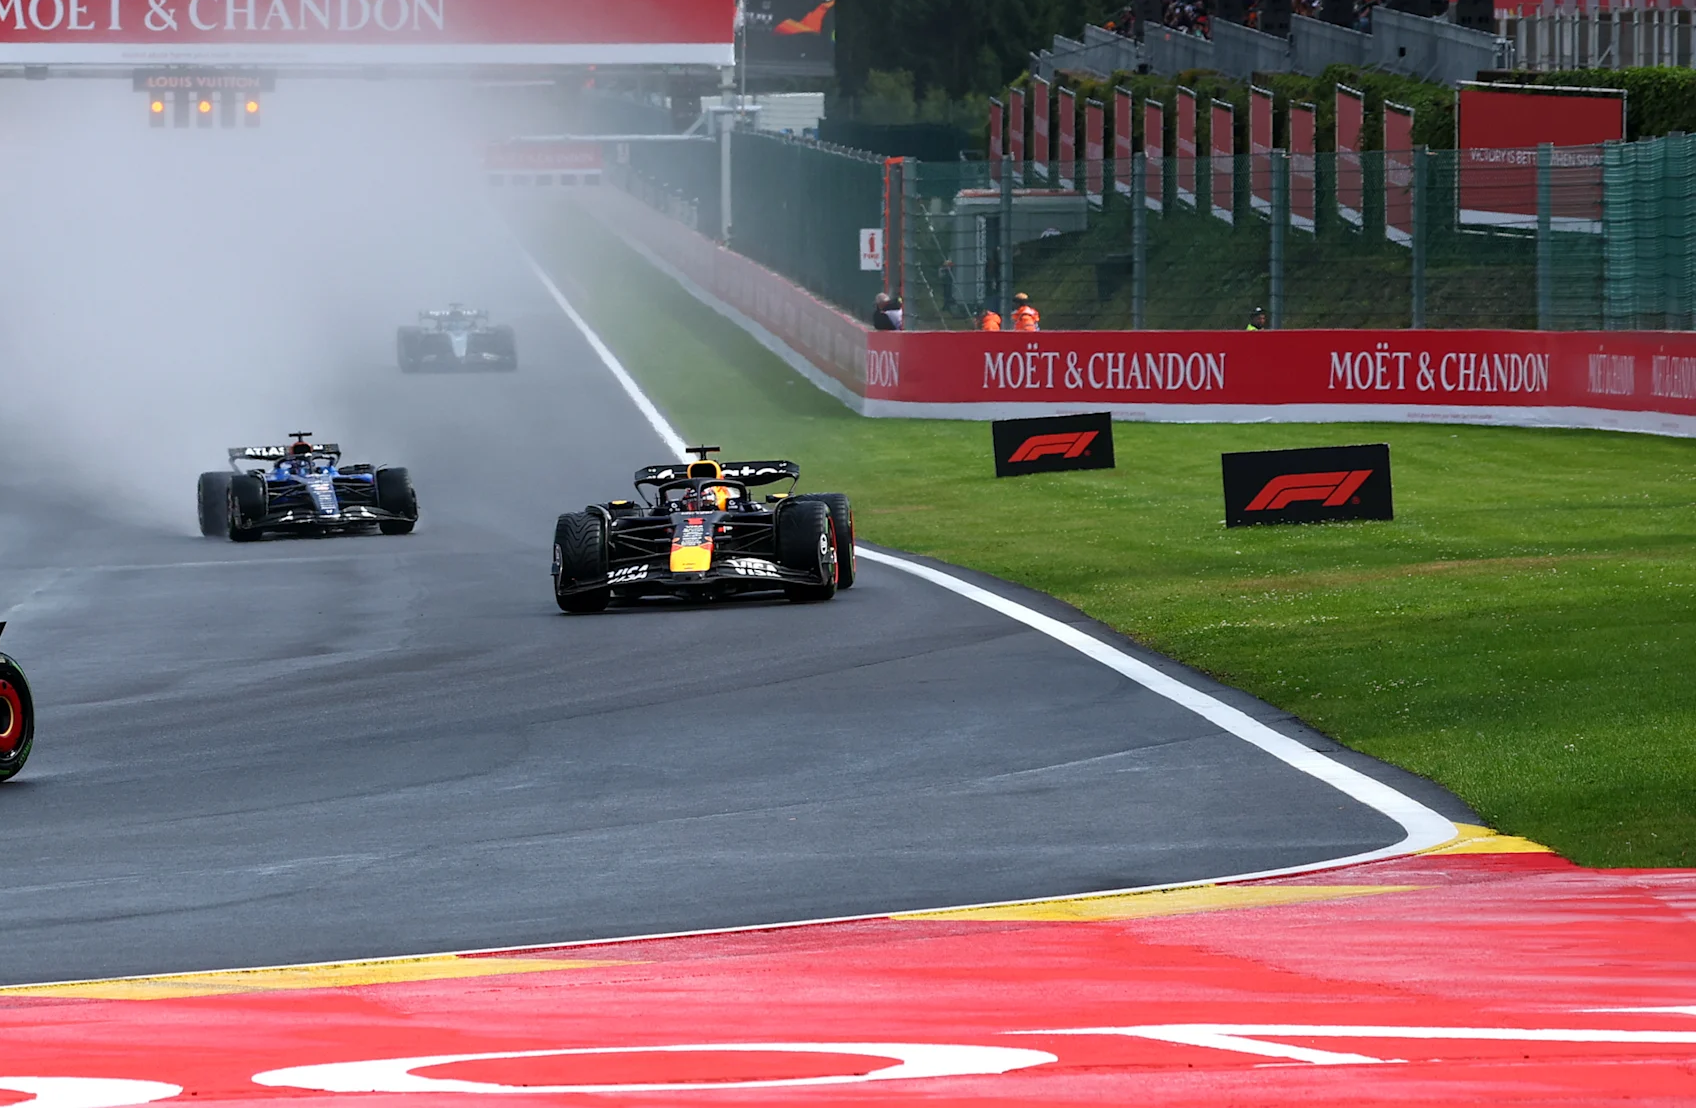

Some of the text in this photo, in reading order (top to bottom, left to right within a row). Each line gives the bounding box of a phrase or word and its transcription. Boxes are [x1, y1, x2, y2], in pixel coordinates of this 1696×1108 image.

[148, 76, 261, 88] LOUIS VUITTON
[1470, 147, 1506, 163] VICTORY
[1506, 150, 1515, 163] IS
[1516, 150, 1537, 165] BETT
[983, 342, 1226, 390] MOËT & CHANDON
[1328, 342, 1550, 392] MOËT & CHANDON
[1008, 430, 1100, 463] F1
[1243, 468, 1373, 510] F1
